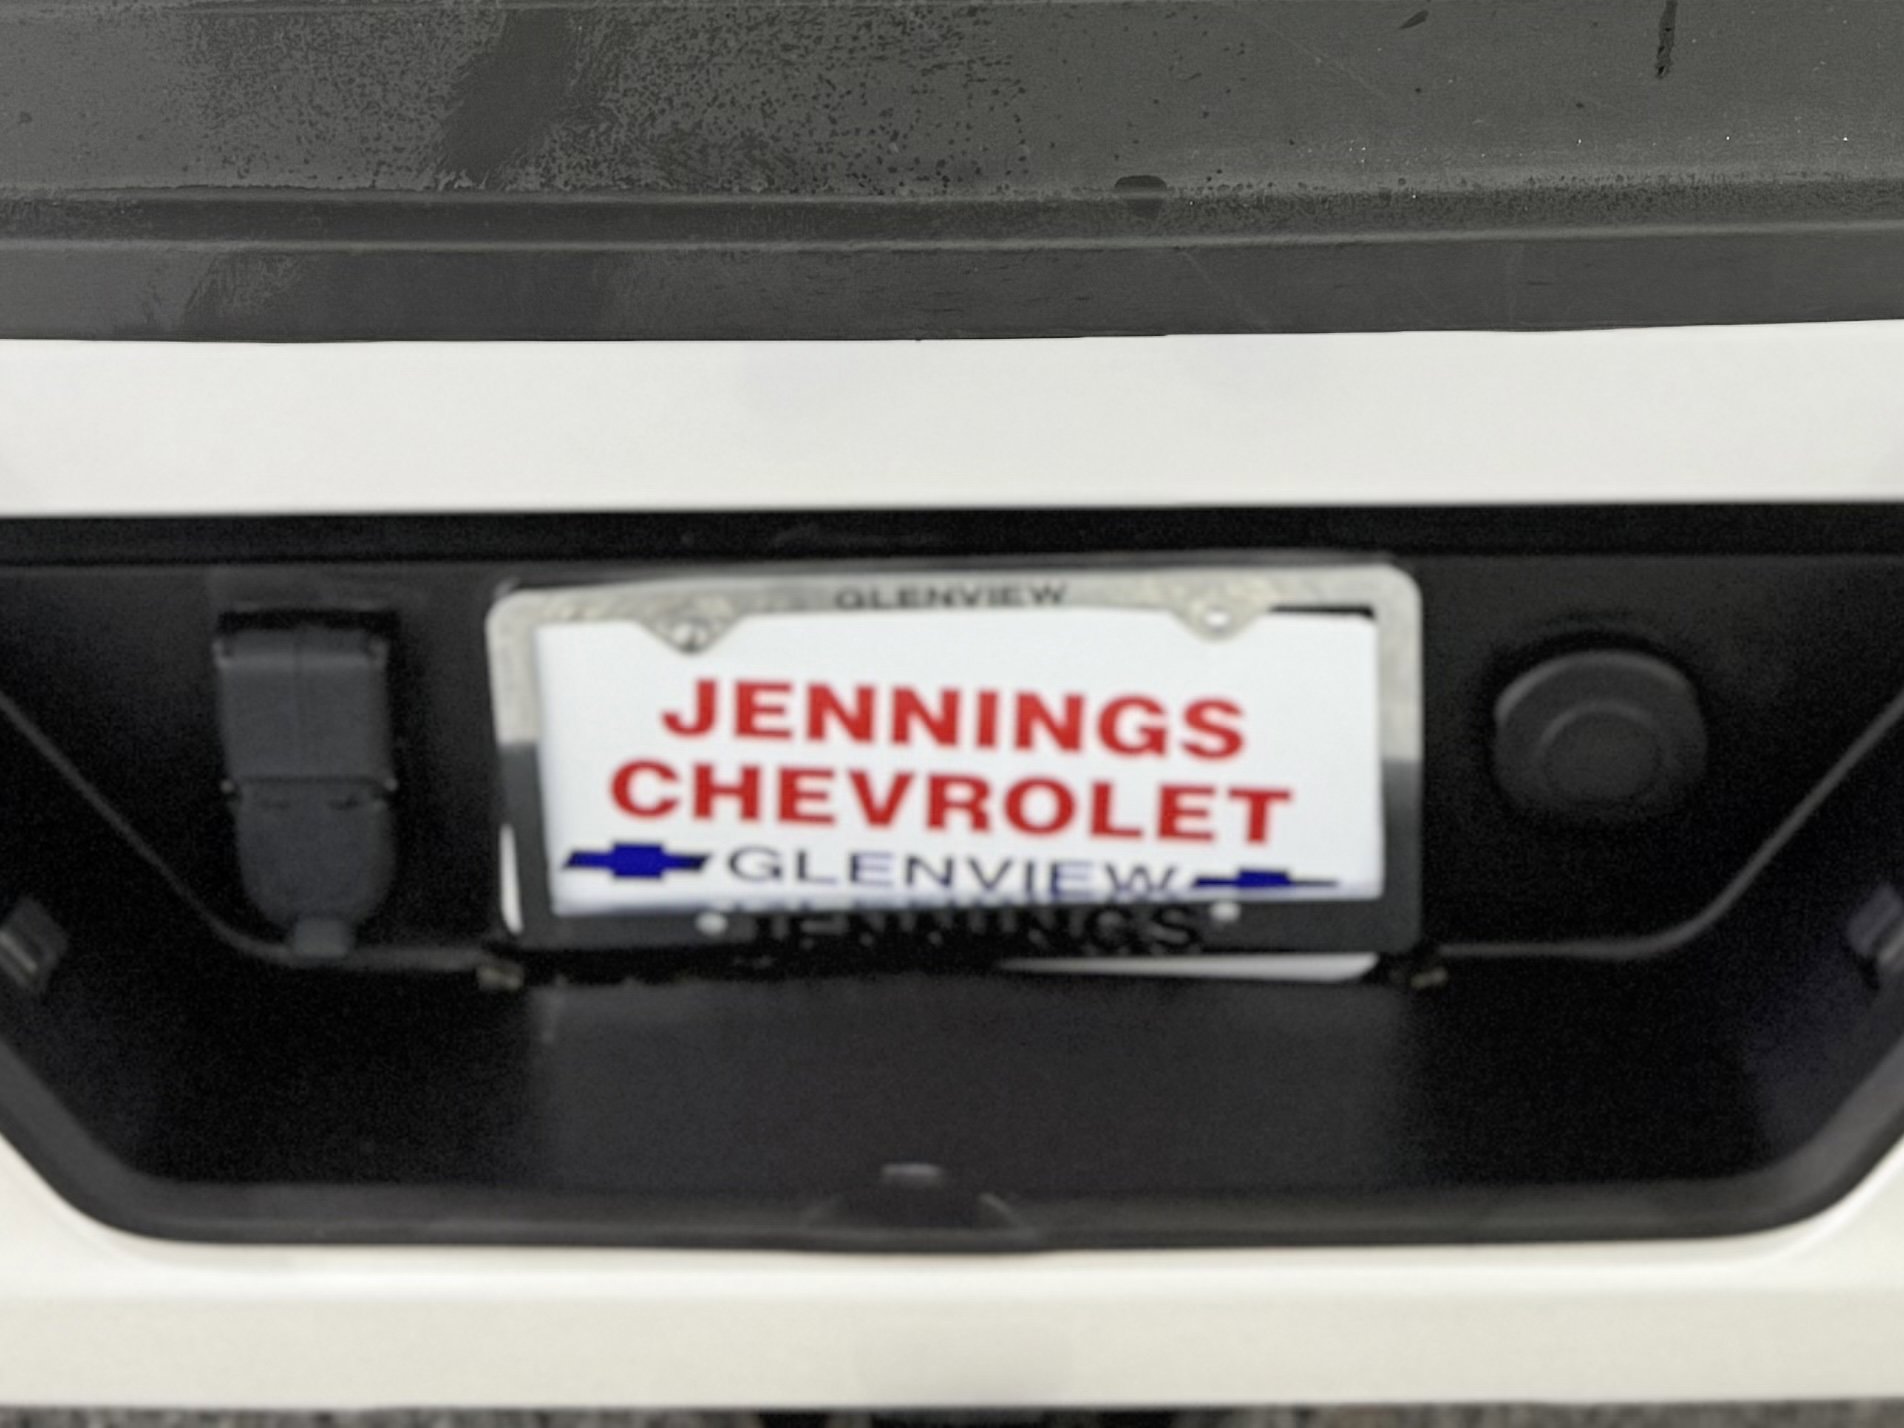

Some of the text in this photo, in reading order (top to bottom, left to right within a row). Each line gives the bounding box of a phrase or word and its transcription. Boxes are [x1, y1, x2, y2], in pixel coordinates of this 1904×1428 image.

[833, 581, 1067, 612] GLENVIEW
[661, 678, 1246, 762] JENNINGS
[609, 759, 1292, 846] CHEVROLET
[726, 846, 1178, 896] GLENVIEW
